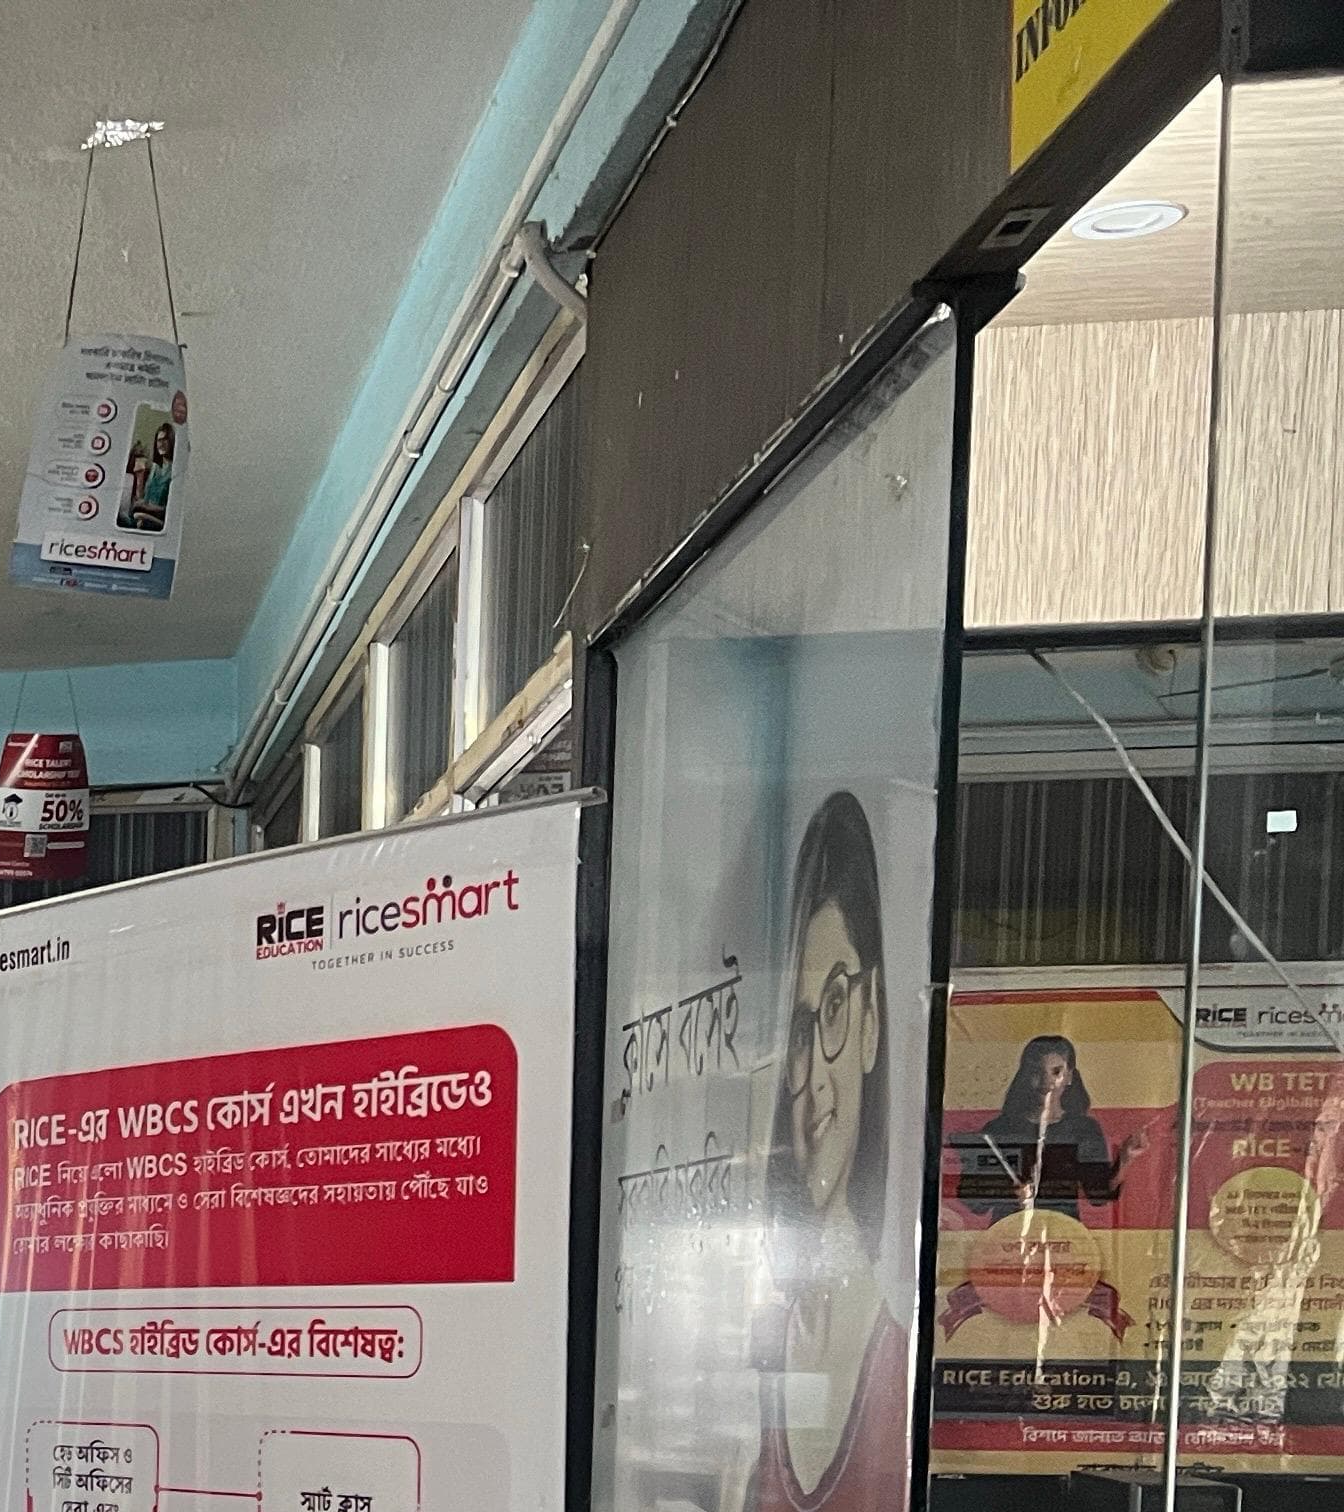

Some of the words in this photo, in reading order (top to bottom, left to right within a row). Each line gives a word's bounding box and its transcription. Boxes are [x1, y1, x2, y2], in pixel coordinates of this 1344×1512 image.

[41, 799, 84, 823] 50%
[254, 901, 325, 947] RICE
[337, 868, 521, 941] ricesmart
[255, 938, 325, 962] EDUCATION
[311, 950, 376, 971] TOGETHER
[379, 948, 393, 963] IN
[398, 939, 456, 960] SUCCESS
[1195, 1004, 1247, 1023] RICE
[1230, 1072, 1274, 1092] WB
[1283, 1072, 1329, 1091] TET
[118, 1100, 199, 1139] WBCS
[280, 1083, 346, 1124] এখন
[14, 1163, 52, 1190] RICE
[126, 1152, 188, 1180] WBCS
[63, 1326, 125, 1358] WBCS
[942, 1369, 992, 1387] RICE
